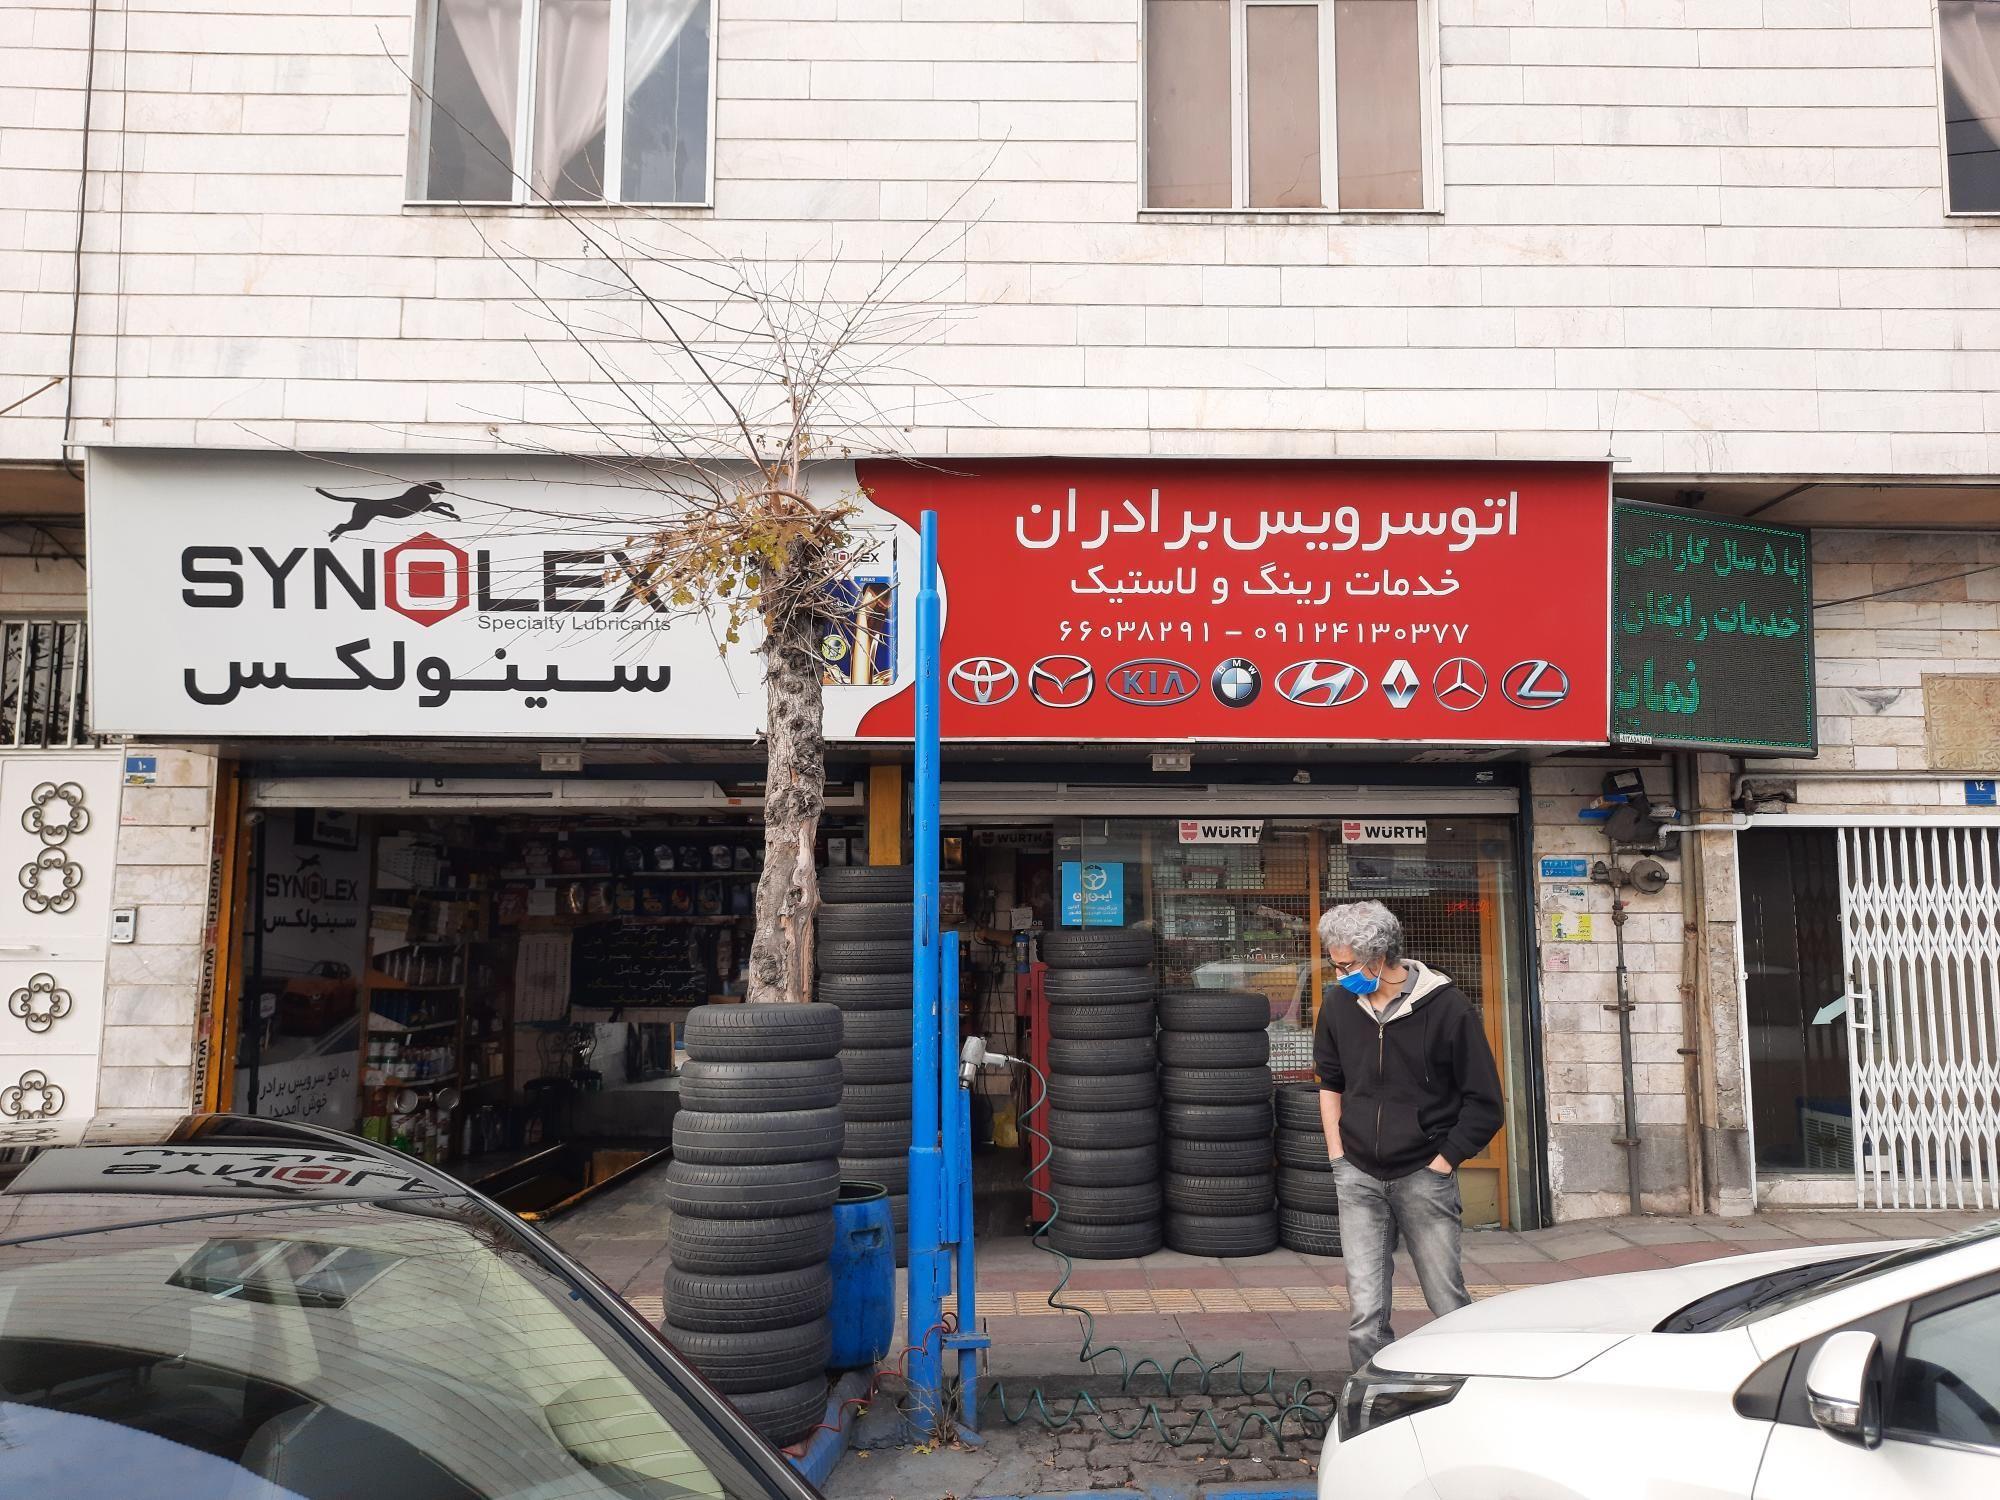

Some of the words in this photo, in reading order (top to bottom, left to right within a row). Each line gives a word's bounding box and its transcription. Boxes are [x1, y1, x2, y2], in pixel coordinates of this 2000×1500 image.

[1016, 488, 1217, 551] برادران
[1223, 491, 1519, 552] اتوسرویس
[1623, 530, 1710, 573] گارانتی
[1713, 538, 1757, 577] سال
[1760, 543, 1777, 576] ۵
[181, 540, 671, 618] SYNOLEX
[1071, 564, 1197, 603] لاستیک
[1211, 580, 1229, 605] و
[1243, 565, 1332, 604] رینگ
[1345, 568, 1460, 597] خدمات
[477, 614, 566, 633] Specialty
[571, 615, 672, 631] Lubricants
[1621, 590, 1709, 641] رایگان
[1713, 601, 1801, 639] خدمات
[1059, 621, 1211, 643] ۶۶۰۳۸۲۹۱
[1254, 620, 1471, 644] ۰۹۱۲۴۱۳۰۳۷۷
[184, 638, 671, 707] سینولکس
[1122, 670, 1187, 694] KIA
[1201, 825, 1263, 839] WÜRTH
[1365, 825, 1427, 839] WÜRTH
[265, 873, 358, 902] SYNOLEX
[263, 907, 358, 933] سینولکس
[288, 1073, 326, 1094] سرویس
[302, 1093, 328, 1117] خوش
